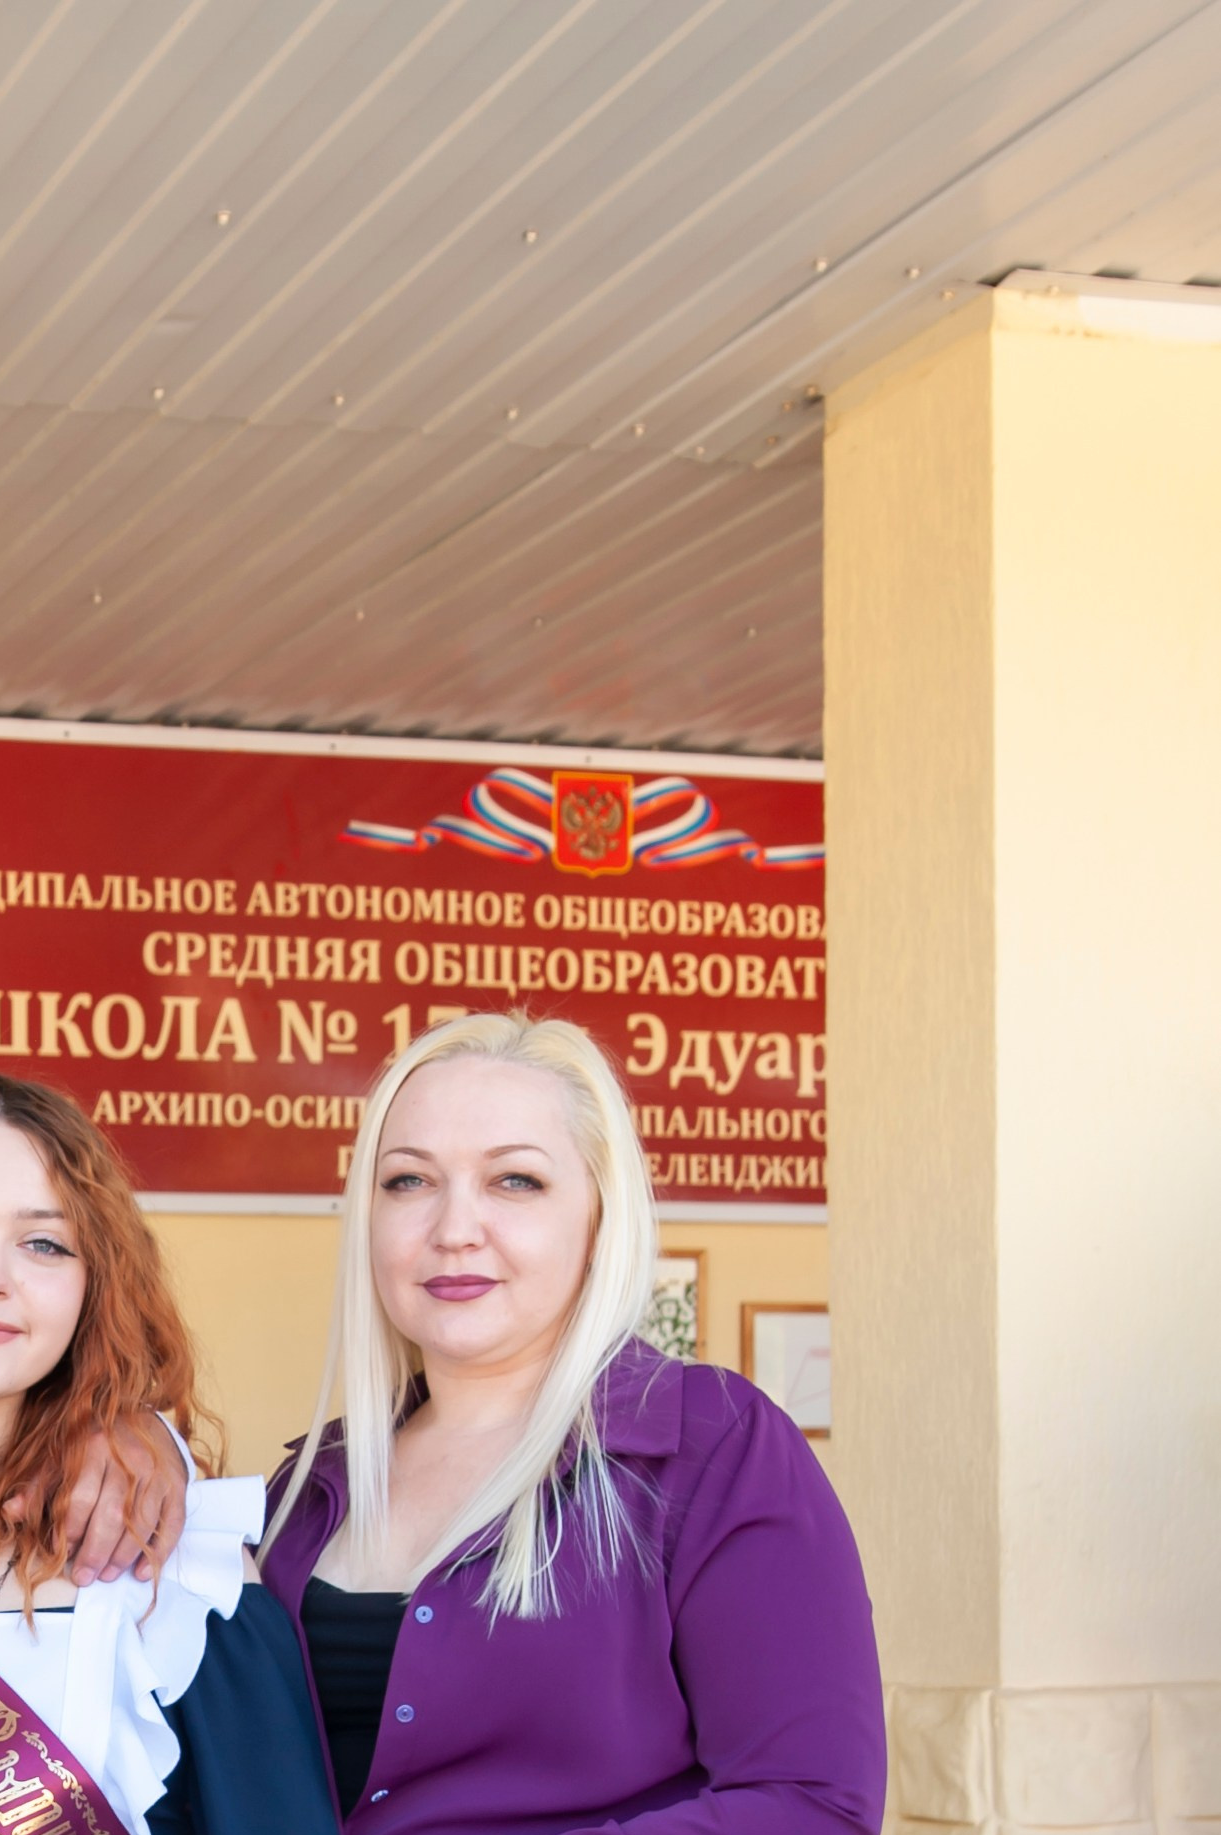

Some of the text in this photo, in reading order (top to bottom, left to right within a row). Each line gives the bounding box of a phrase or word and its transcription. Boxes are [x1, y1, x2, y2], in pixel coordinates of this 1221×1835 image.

[246, 882, 525, 927] АВТОНОМНОЕ
[533, 895, 826, 941] ОБЩЕОБРАЗОВ
[142, 931, 826, 999] СРЕДНЯЯ ОБЩЕОБРАЗОВАТ
[277, 1000, 358, 1064] №
[626, 1012, 826, 1096] Эдуар
[651, 1152, 826, 1193] ЕЛЕНДЖИ
